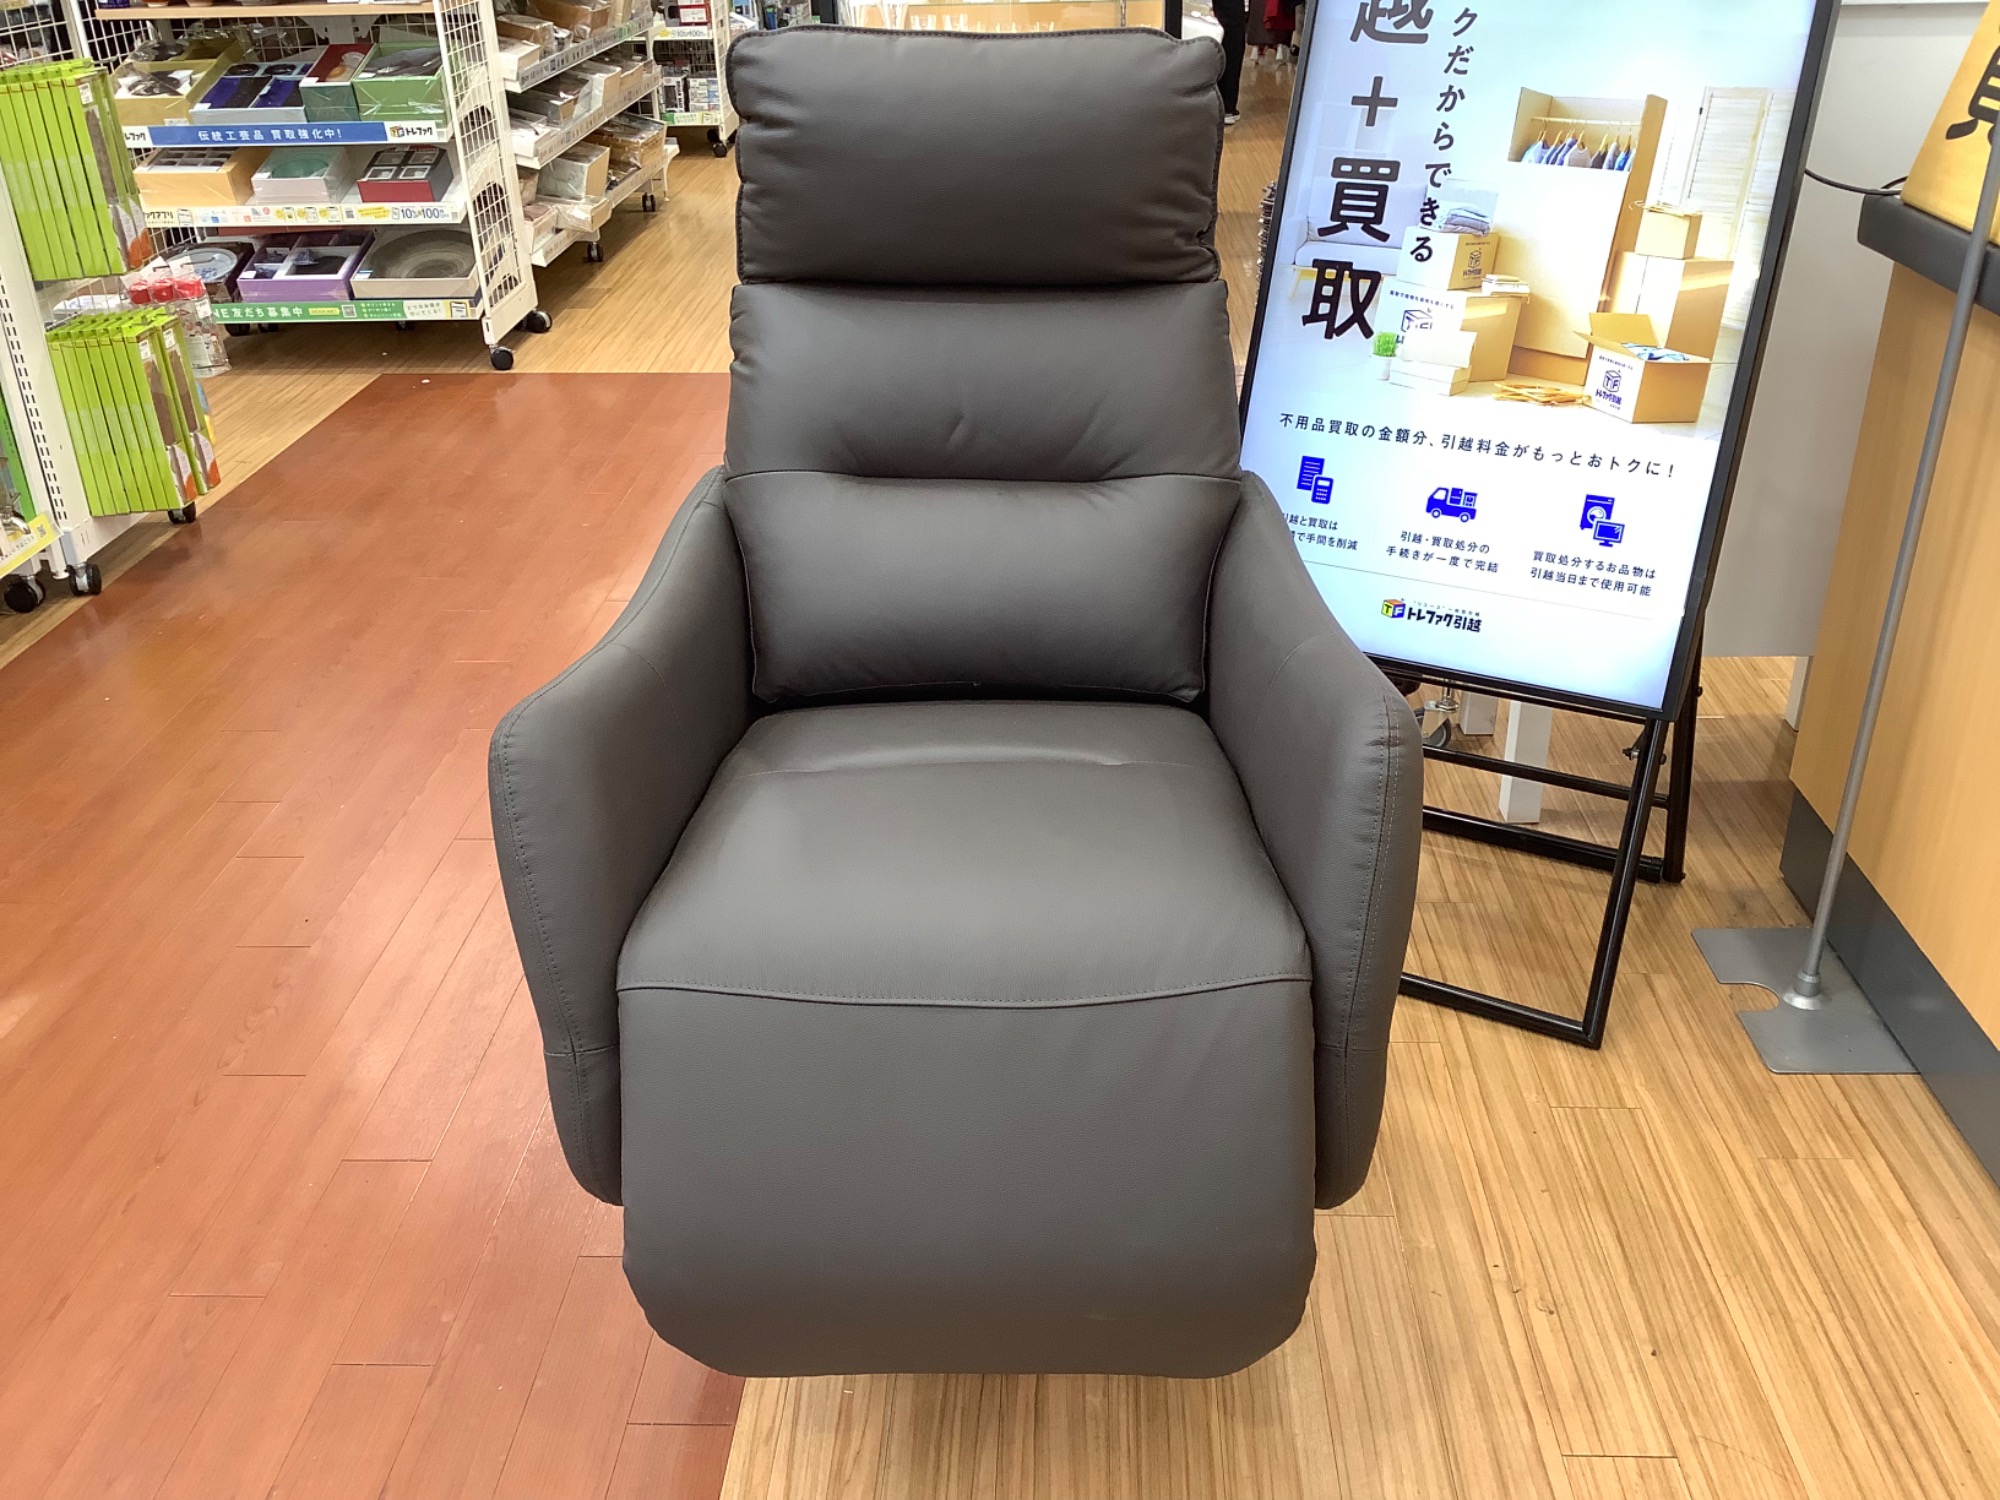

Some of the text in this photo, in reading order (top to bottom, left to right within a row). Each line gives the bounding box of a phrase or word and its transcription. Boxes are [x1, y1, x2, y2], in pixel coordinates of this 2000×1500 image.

[198, 127, 343, 142] 伝統工芸品 買取強化中!
[405, 126, 433, 136] トレファク
[1291, 530, 1358, 551] で手間を削減
[1386, 545, 1499, 573] 手続きが一度で完結
[1532, 550, 1656, 579] 買取処分するお品物は
[1530, 566, 1652, 597] 引越当日まで使用可能
[1406, 607, 1482, 633] トレファク引越
